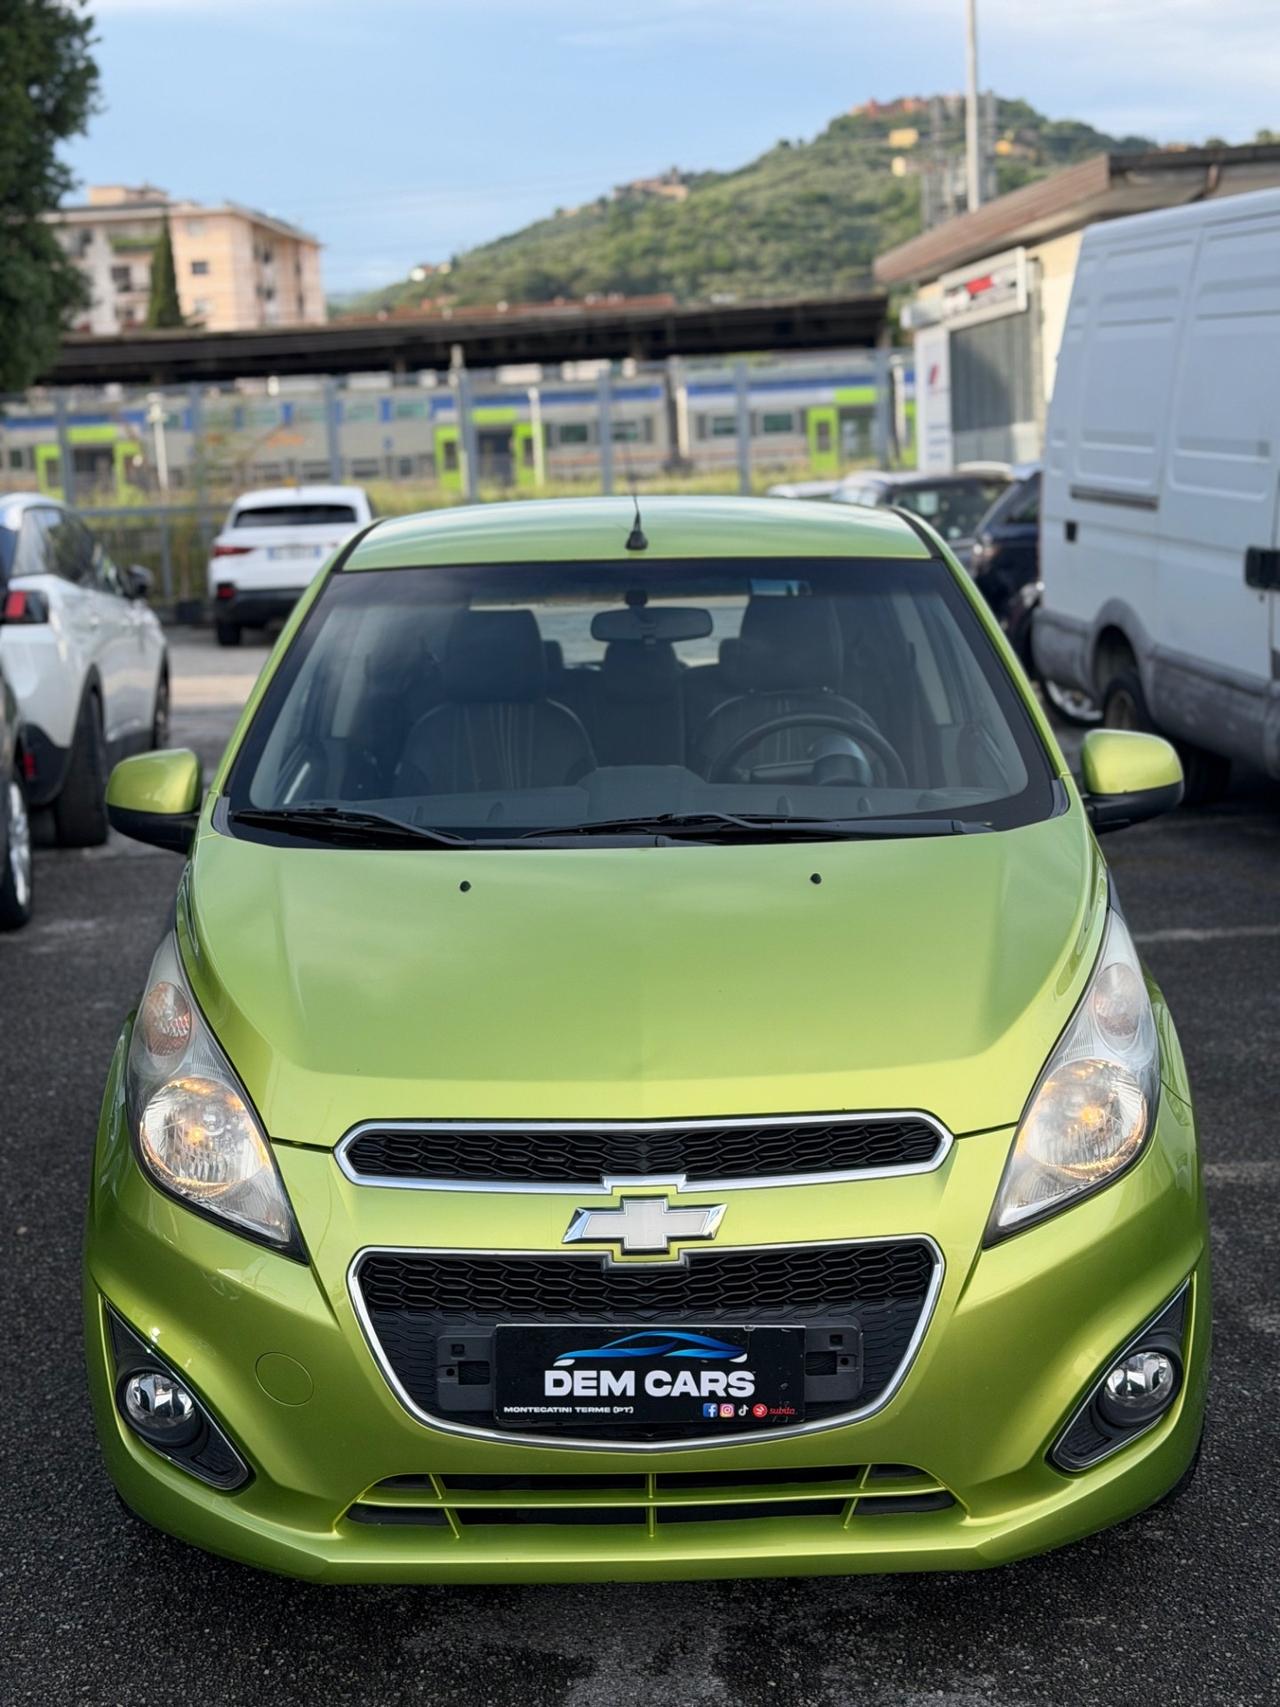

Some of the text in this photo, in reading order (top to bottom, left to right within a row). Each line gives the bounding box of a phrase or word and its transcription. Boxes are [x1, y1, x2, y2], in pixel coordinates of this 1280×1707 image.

[544, 1370, 756, 1397] DEM CARS
[503, 1406, 634, 1414] MONTECATINI TERME (PT)
